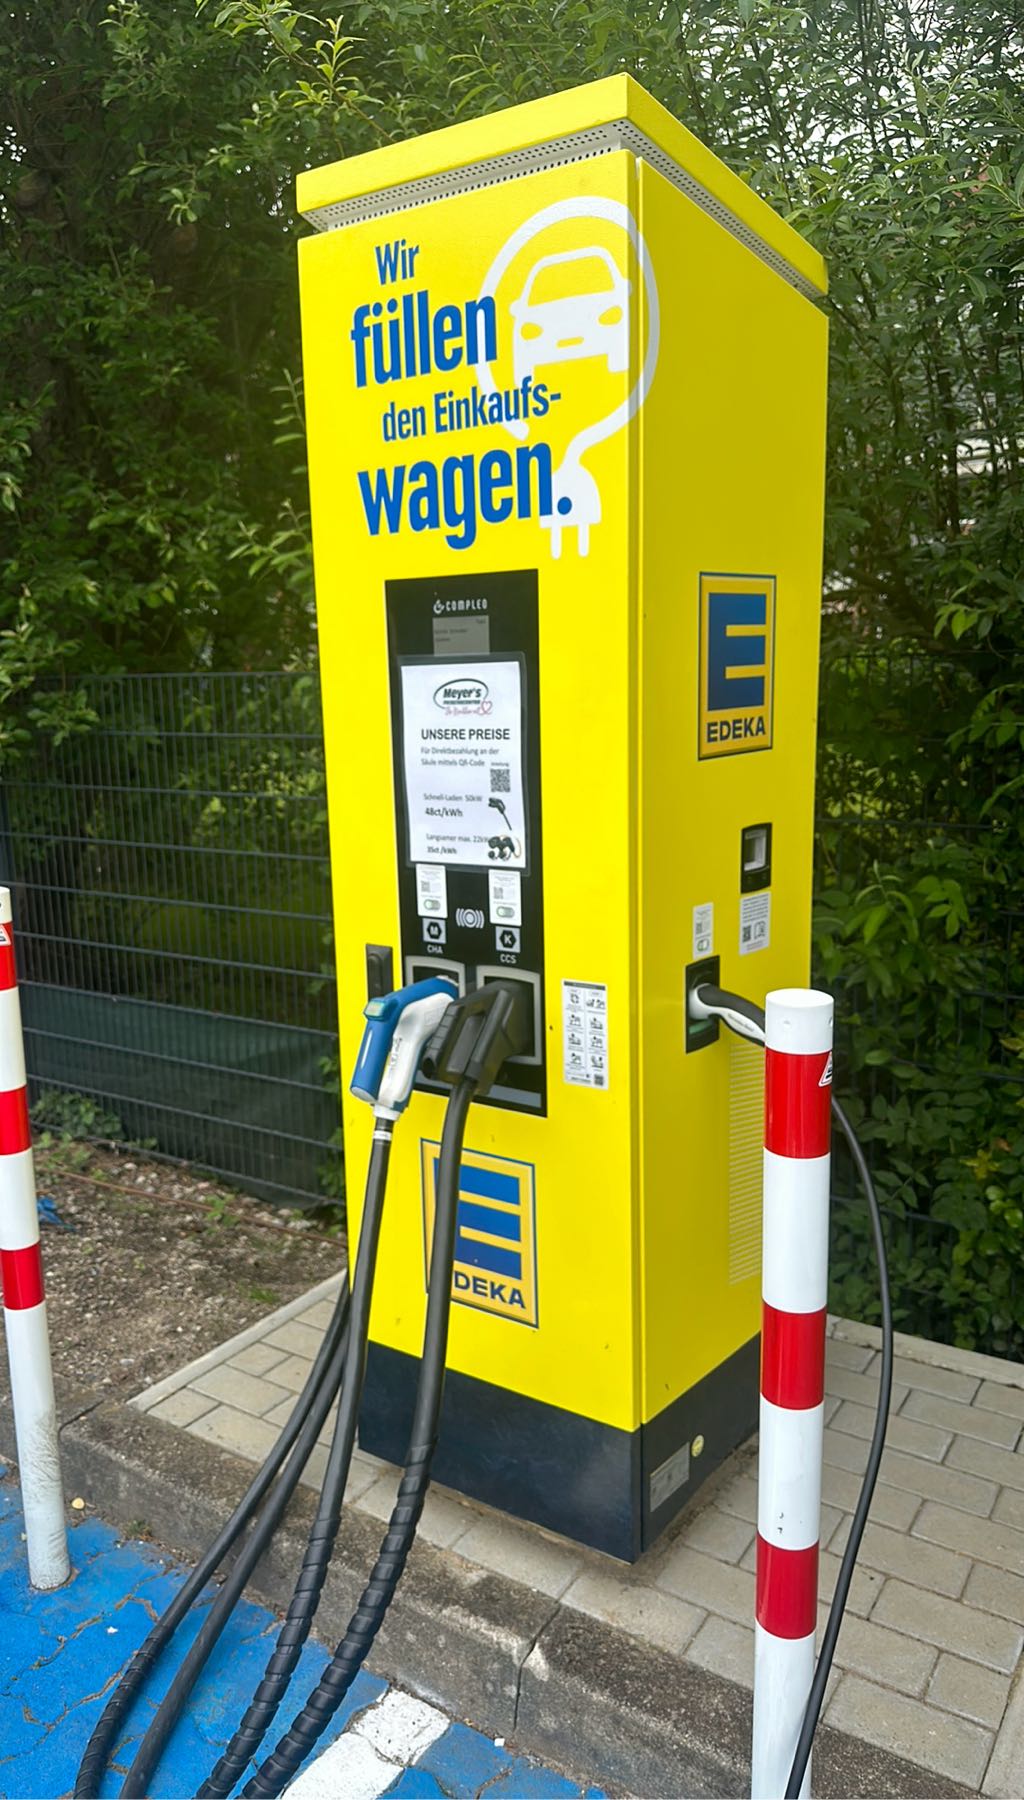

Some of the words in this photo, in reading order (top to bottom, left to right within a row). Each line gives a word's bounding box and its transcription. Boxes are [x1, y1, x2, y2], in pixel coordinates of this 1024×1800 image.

[375, 239, 419, 286] Wir
[351, 290, 497, 388] füllen
[382, 402, 427, 442] den
[434, 375, 561, 433] Einkaufs-
[357, 442, 573, 550] wagen.
[446, 598, 488, 611] COMPLEO
[707, 592, 766, 711] E
[443, 688, 482, 700] Meyer's
[421, 729, 466, 740] UNSERE
[468, 729, 510, 740] PREISE
[707, 716, 766, 743] EDEKA
[504, 934, 512, 944] K
[500, 954, 516, 964] CCS
[454, 1270, 526, 1309] DEKA
